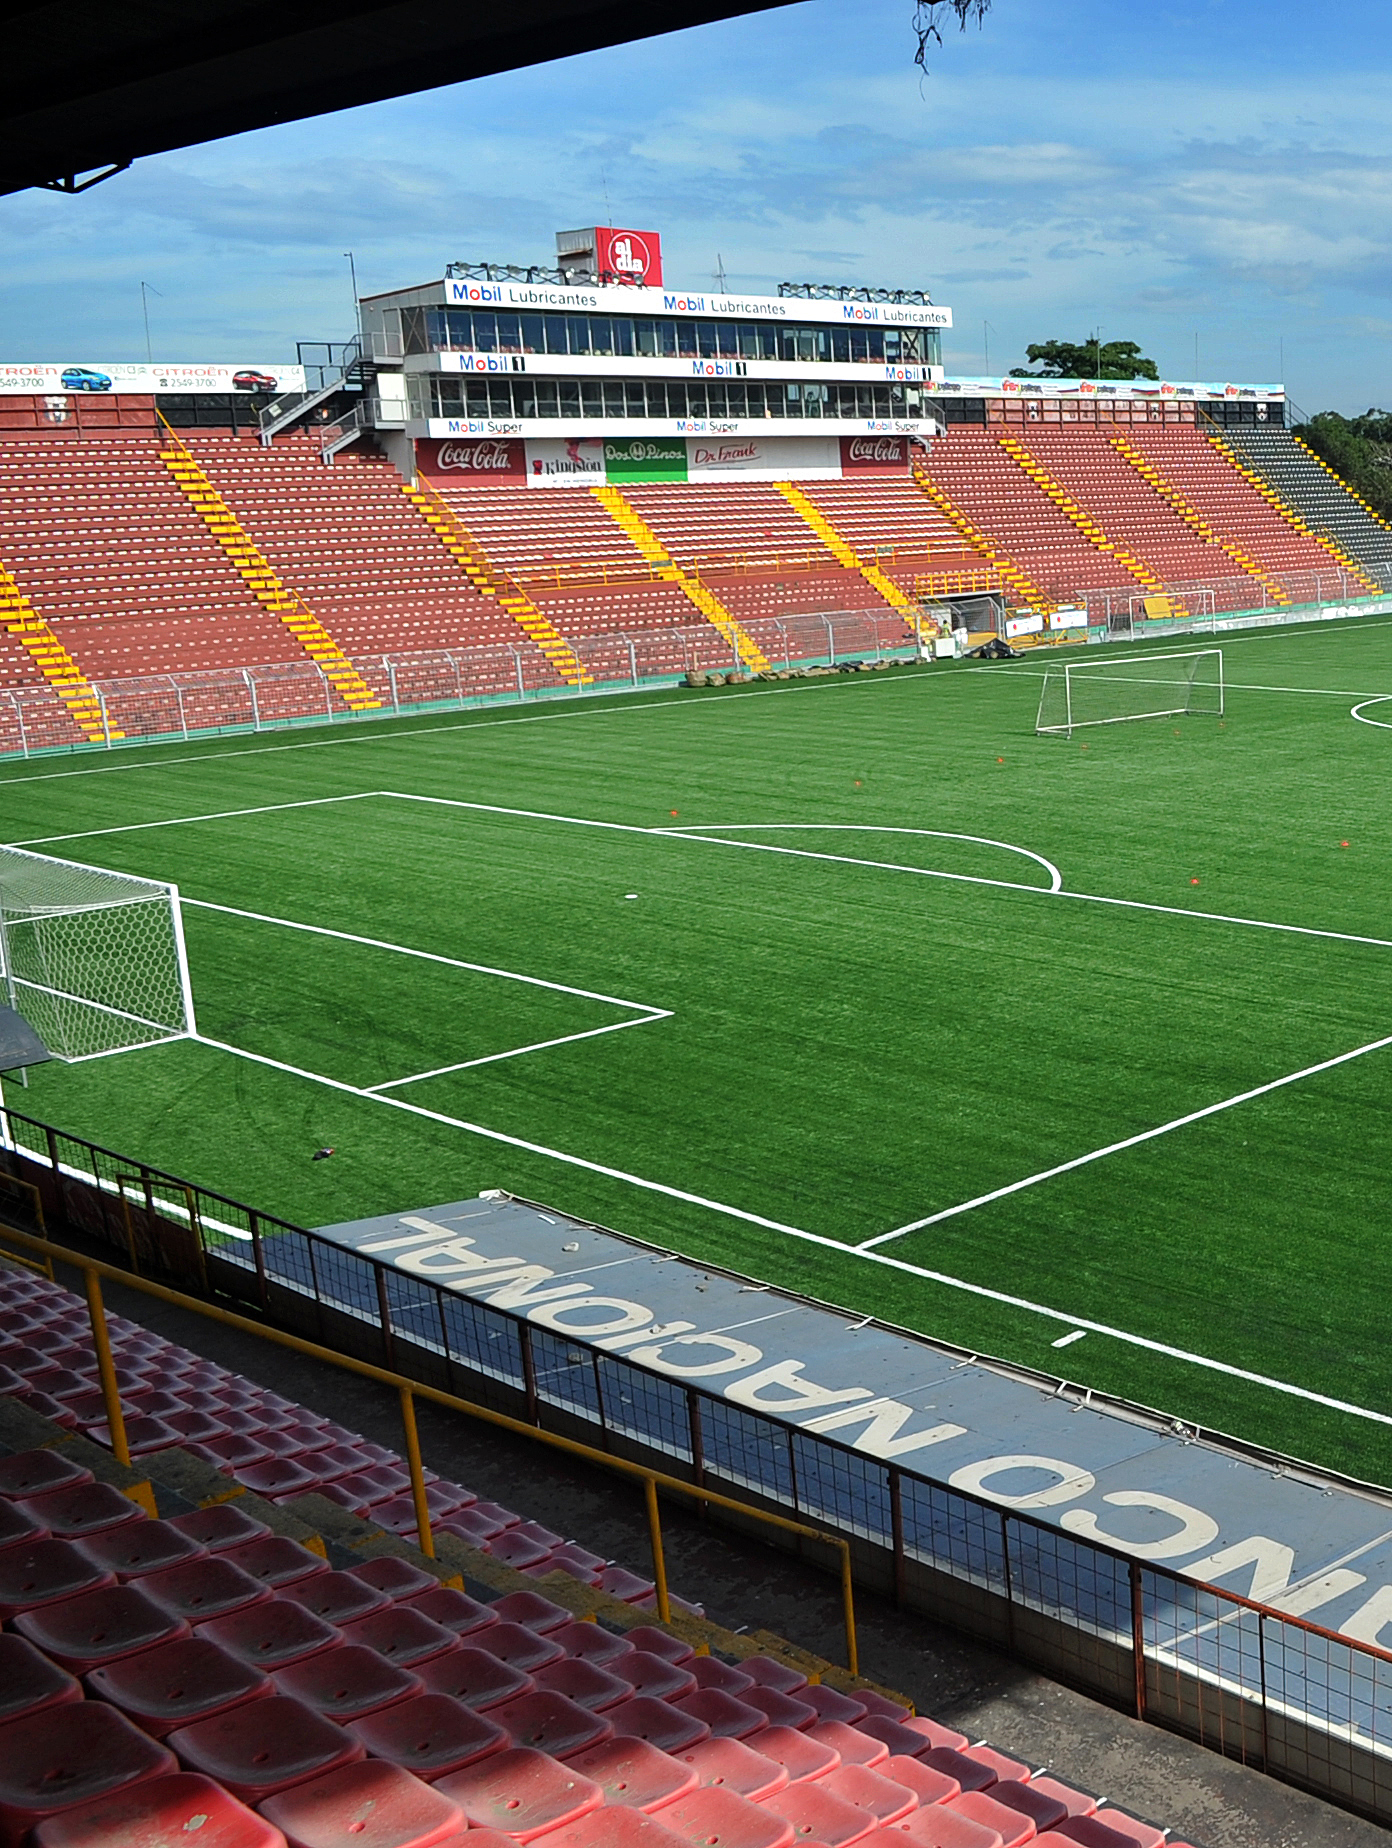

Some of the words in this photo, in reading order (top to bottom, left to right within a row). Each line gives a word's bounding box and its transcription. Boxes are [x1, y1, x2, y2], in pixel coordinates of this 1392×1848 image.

[615, 238, 631, 255] al
[453, 283, 502, 301] Mobil
[509, 288, 597, 307] Lubricantes
[664, 295, 705, 312] Mobil
[711, 300, 786, 316] Lubricantes
[843, 305, 878, 320] Mobil
[883, 309, 947, 324] Lubricantes
[459, 354, 508, 371] Mobil
[692, 361, 732, 376] Mobil
[885, 366, 919, 380] Mobil
[448, 421, 484, 433] Mobil
[487, 421, 523, 434] Super
[676, 420, 707, 432] Mobil
[709, 421, 739, 433] Super
[867, 421, 893, 431] Mobil
[895, 421, 920, 432] Super
[437, 440, 511, 470] Coca-Cola
[605, 445, 631, 460] Dos
[646, 444, 686, 460] Pinos
[718, 442, 758, 461] Frank
[850, 437, 902, 462] Coca-Cola
[545, 456, 602, 475] Kingston
[356, 1215, 968, 1461] NACIONAL
